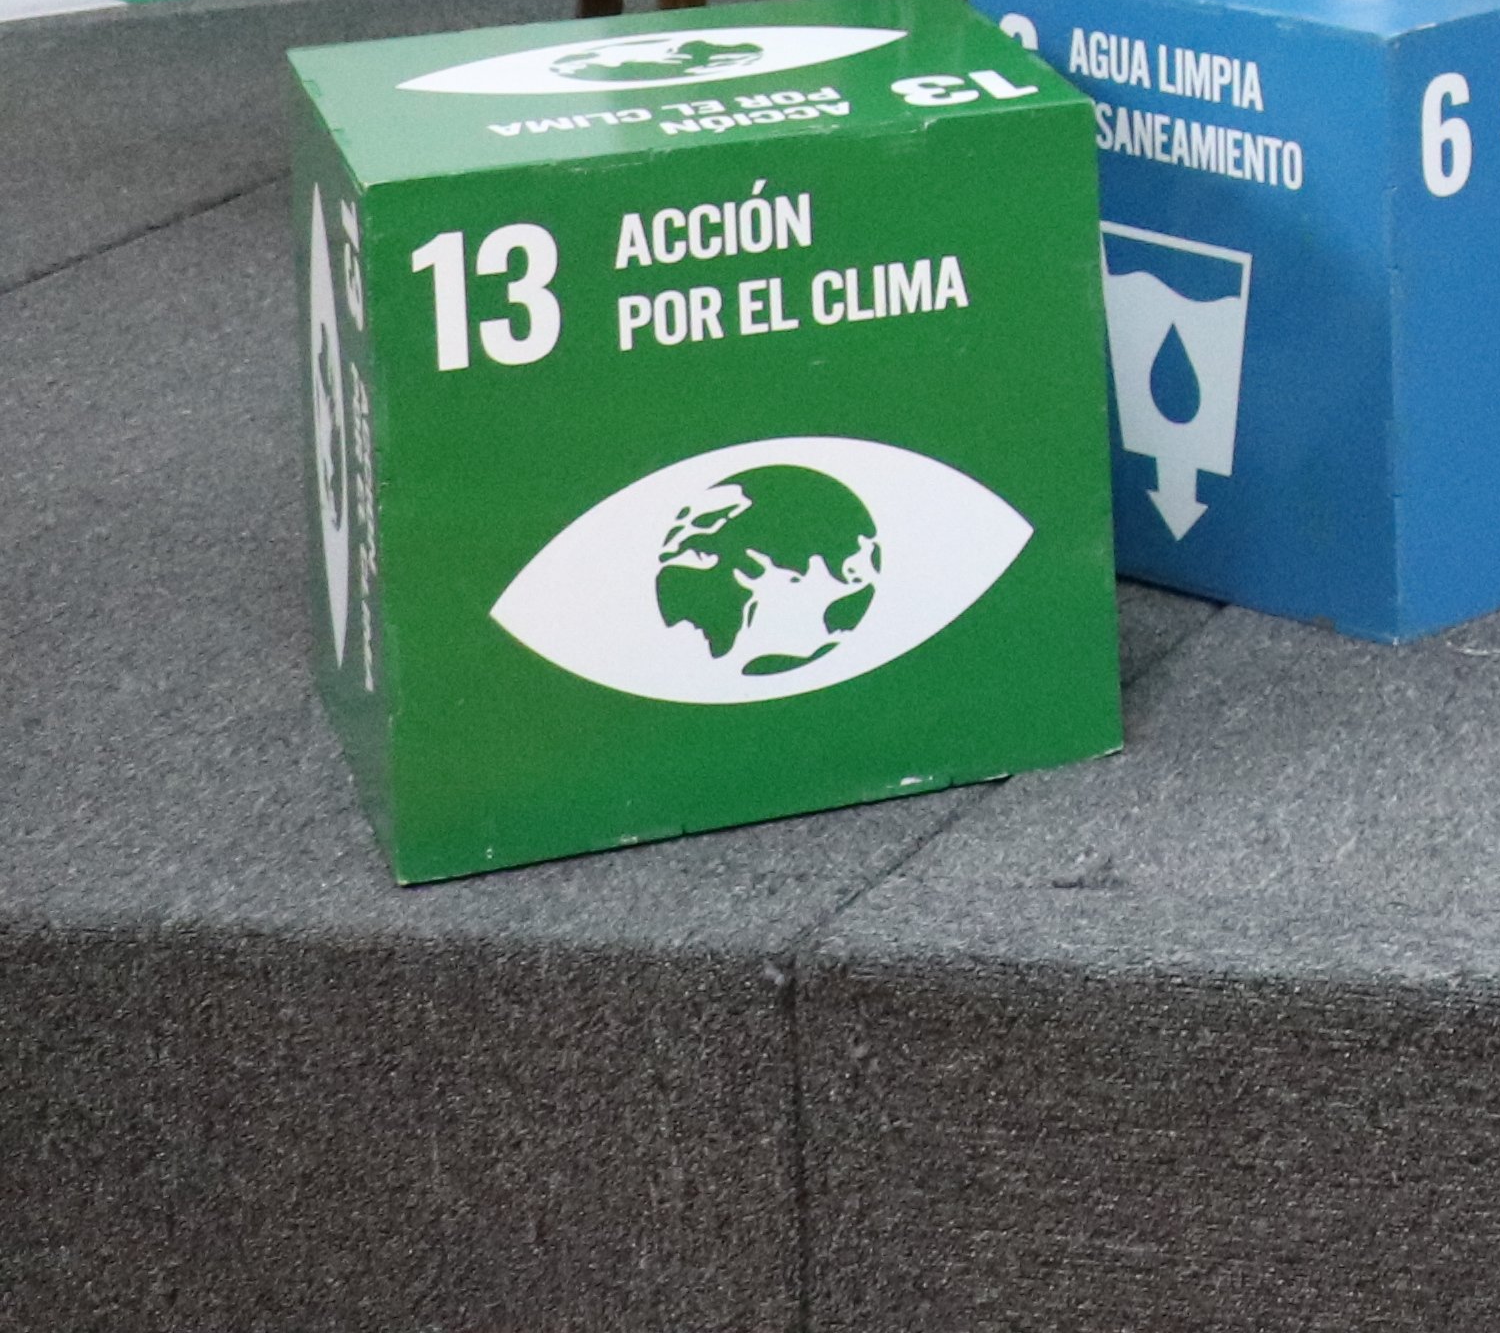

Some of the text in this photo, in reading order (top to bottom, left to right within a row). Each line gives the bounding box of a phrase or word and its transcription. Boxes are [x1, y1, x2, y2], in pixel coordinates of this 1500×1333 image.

[488, 86, 841, 137] POR EL CLIMA
[892, 71, 1037, 105] 13
[1070, 29, 1150, 87] AGUA
[1159, 45, 1263, 110] LIMPIA
[1095, 104, 1302, 189] SANEAMIENTO
[1422, 73, 1471, 196] 6
[615, 180, 812, 270] ACCIÓN
[412, 224, 560, 370] 13
[618, 256, 968, 350] POR EL CLIMA
